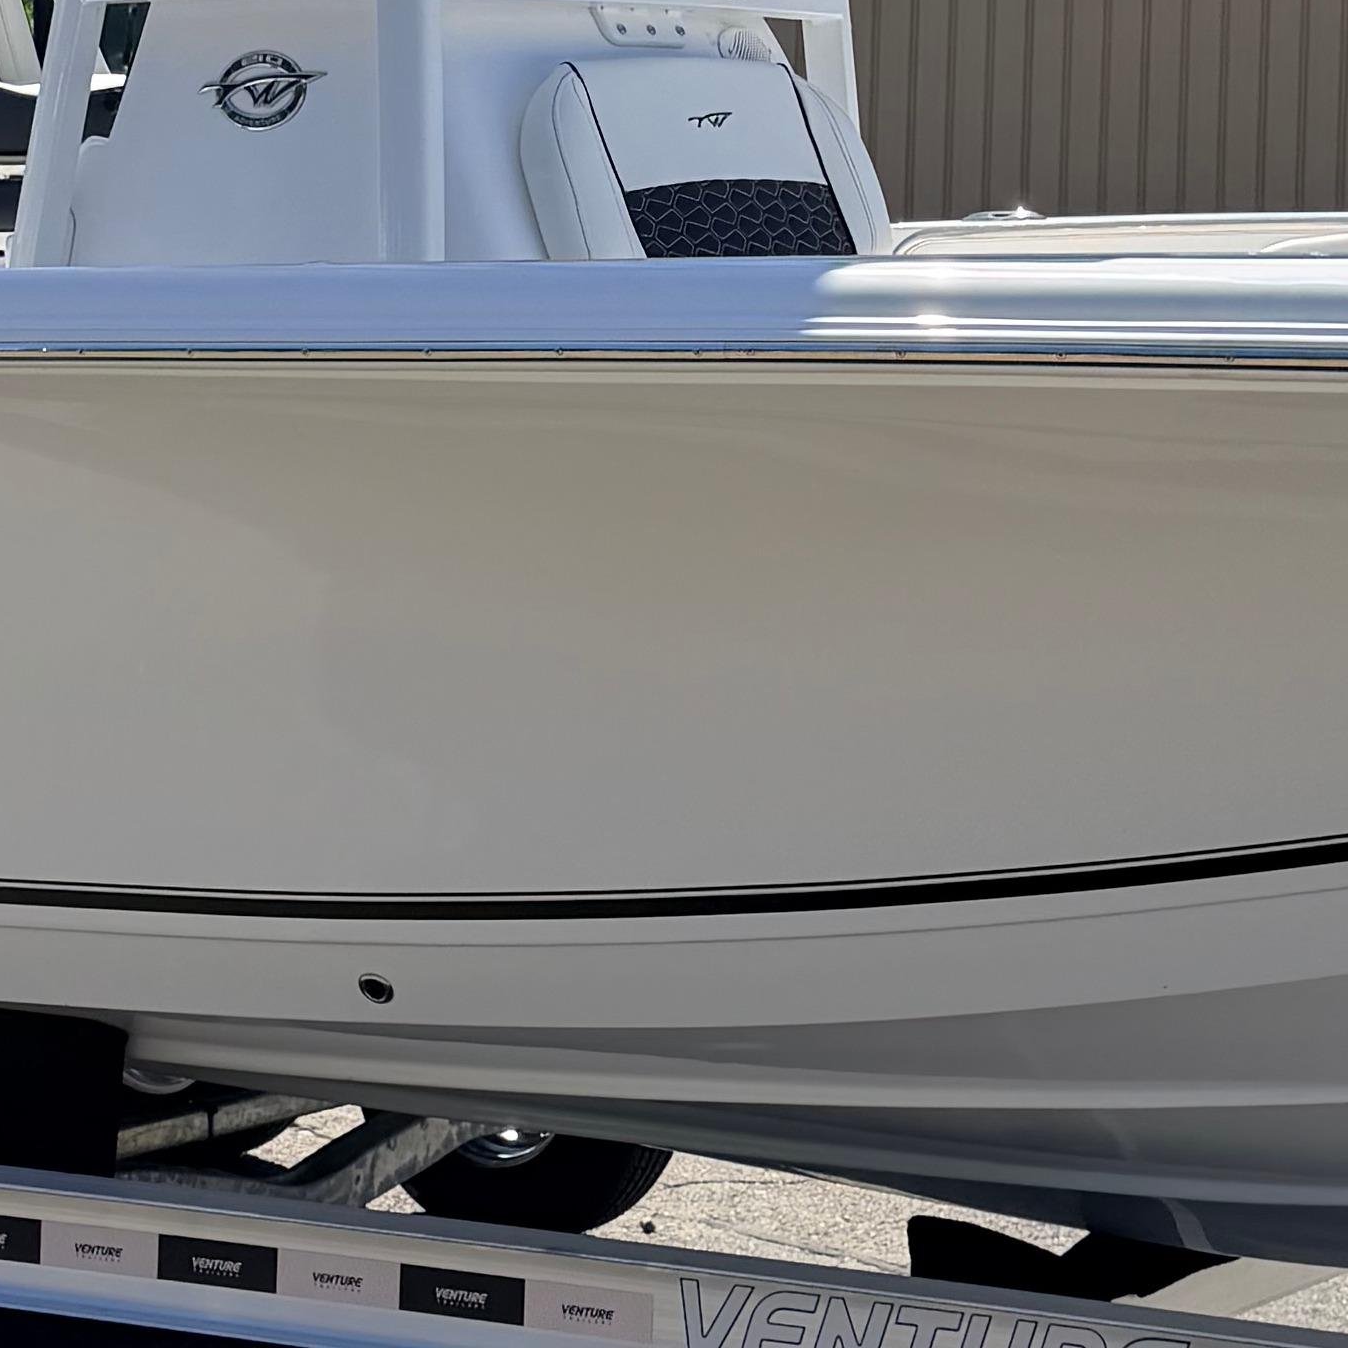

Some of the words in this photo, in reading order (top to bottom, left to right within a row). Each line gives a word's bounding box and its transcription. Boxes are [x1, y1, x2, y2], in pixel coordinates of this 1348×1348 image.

[192, 1257, 242, 1273] VENTURE
[312, 1272, 363, 1288] VENTURE
[436, 1287, 488, 1304] VENTURE
[562, 1304, 615, 1320] VENTURE
[680, 1278, 1191, 1348] VENT
